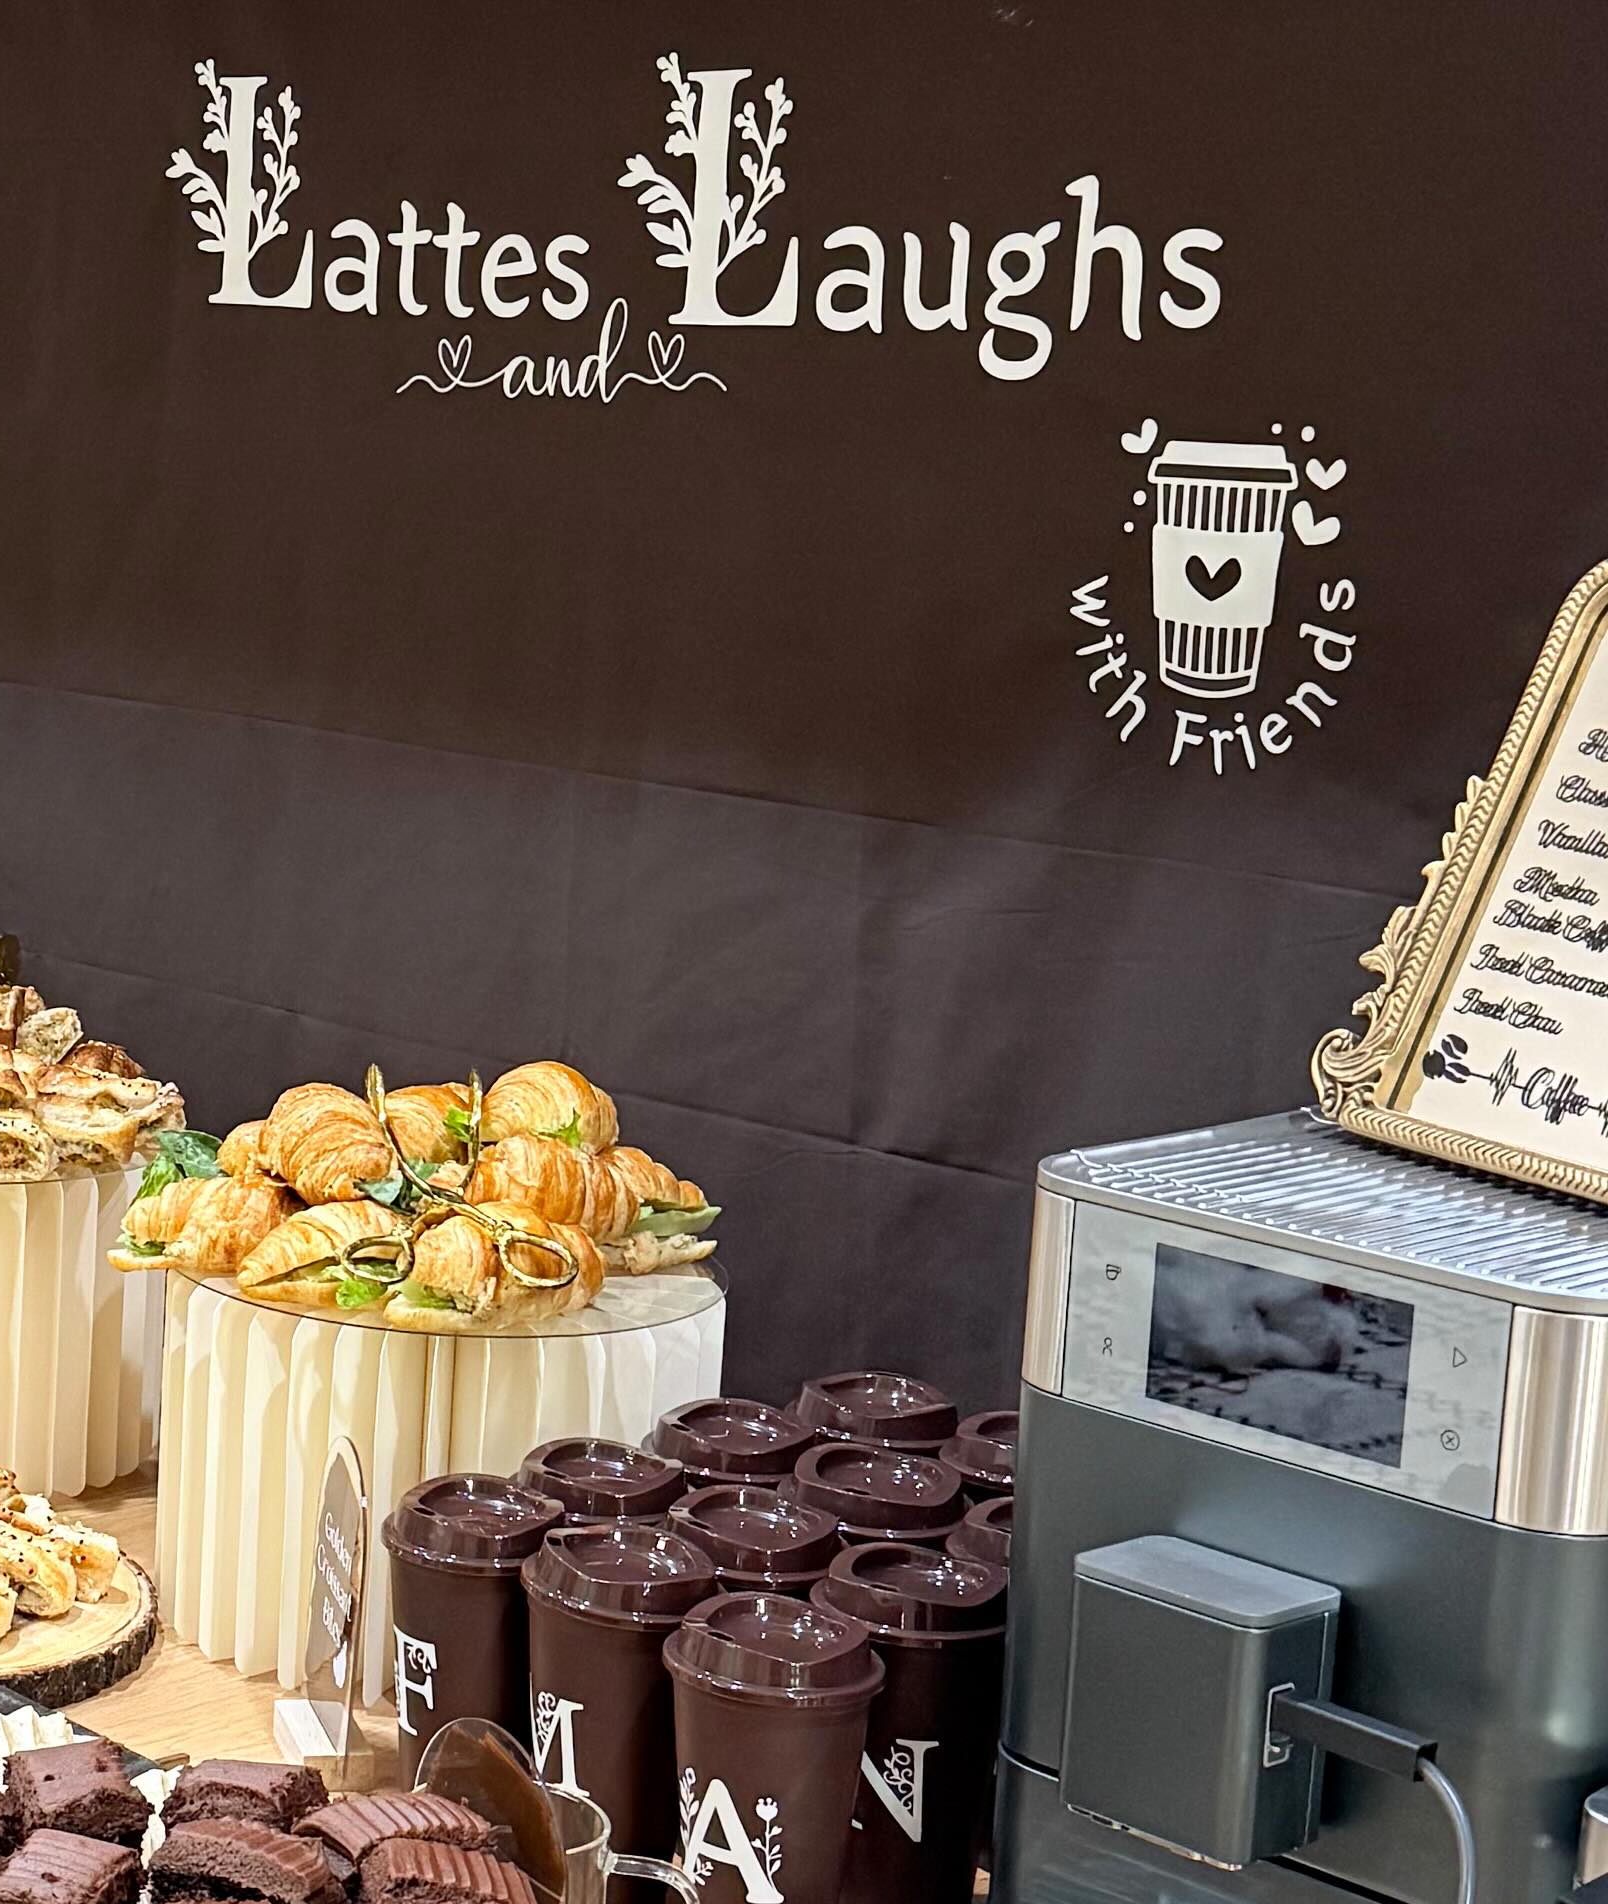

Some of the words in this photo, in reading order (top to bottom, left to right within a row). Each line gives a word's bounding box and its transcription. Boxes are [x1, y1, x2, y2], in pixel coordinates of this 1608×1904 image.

[166, 59, 591, 322] Lattes
[619, 52, 1224, 381] Laughs
[503, 298, 630, 402] and
[1169, 578, 1357, 776] Friends
[1493, 899, 1563, 936] Black
[1563, 914, 1608, 953] Coff
[1525, 955, 1608, 998] Carame
[1522, 1066, 1590, 1126] Coffee
[324, 1512, 352, 1577] Golden
[393, 1623, 438, 1737] F
[681, 1772, 785, 1904] A
